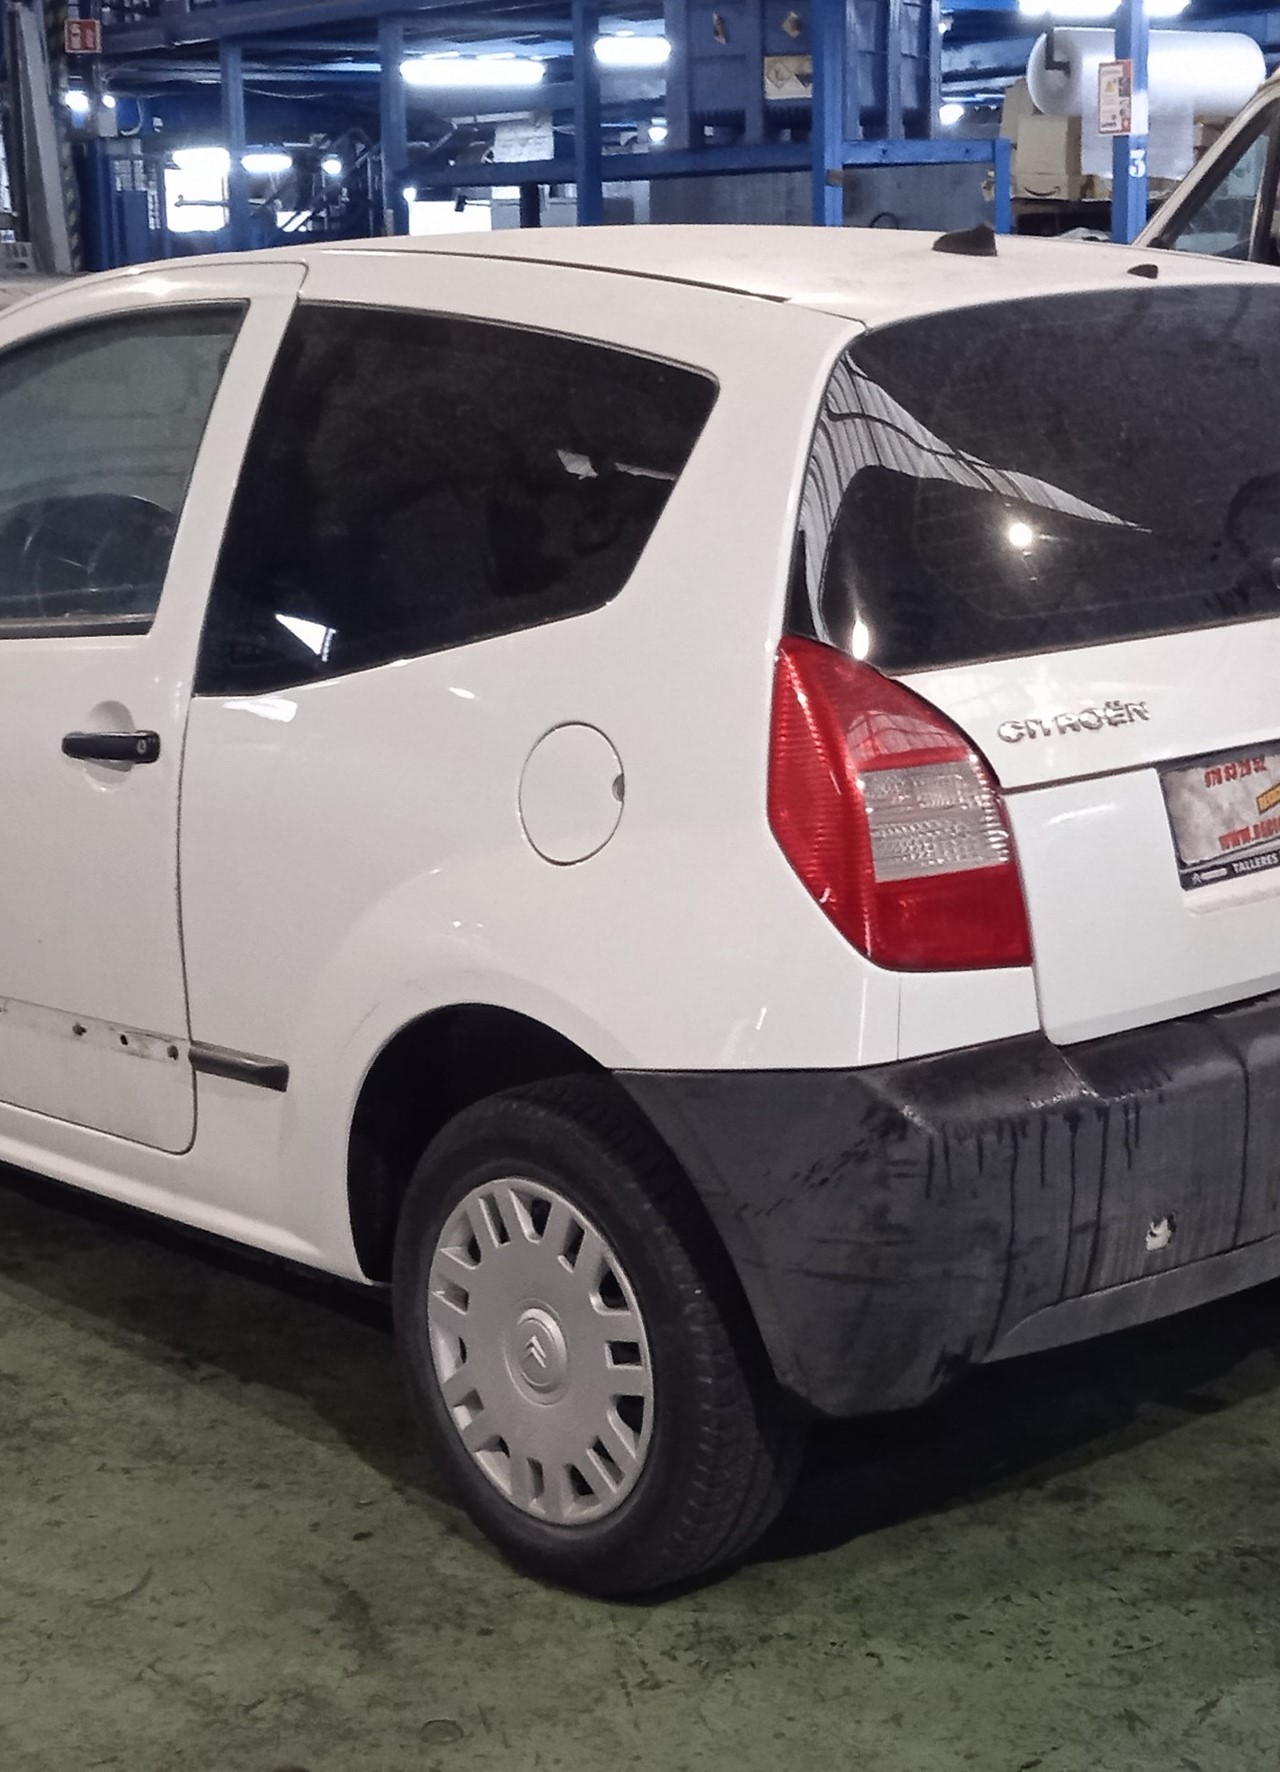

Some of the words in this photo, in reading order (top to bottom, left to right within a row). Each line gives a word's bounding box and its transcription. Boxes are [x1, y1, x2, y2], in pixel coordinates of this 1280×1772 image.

[1128, 148, 1147, 178] 3
[997, 700, 1150, 743] CITROËN
[1231, 854, 1278, 874] TALLERES
